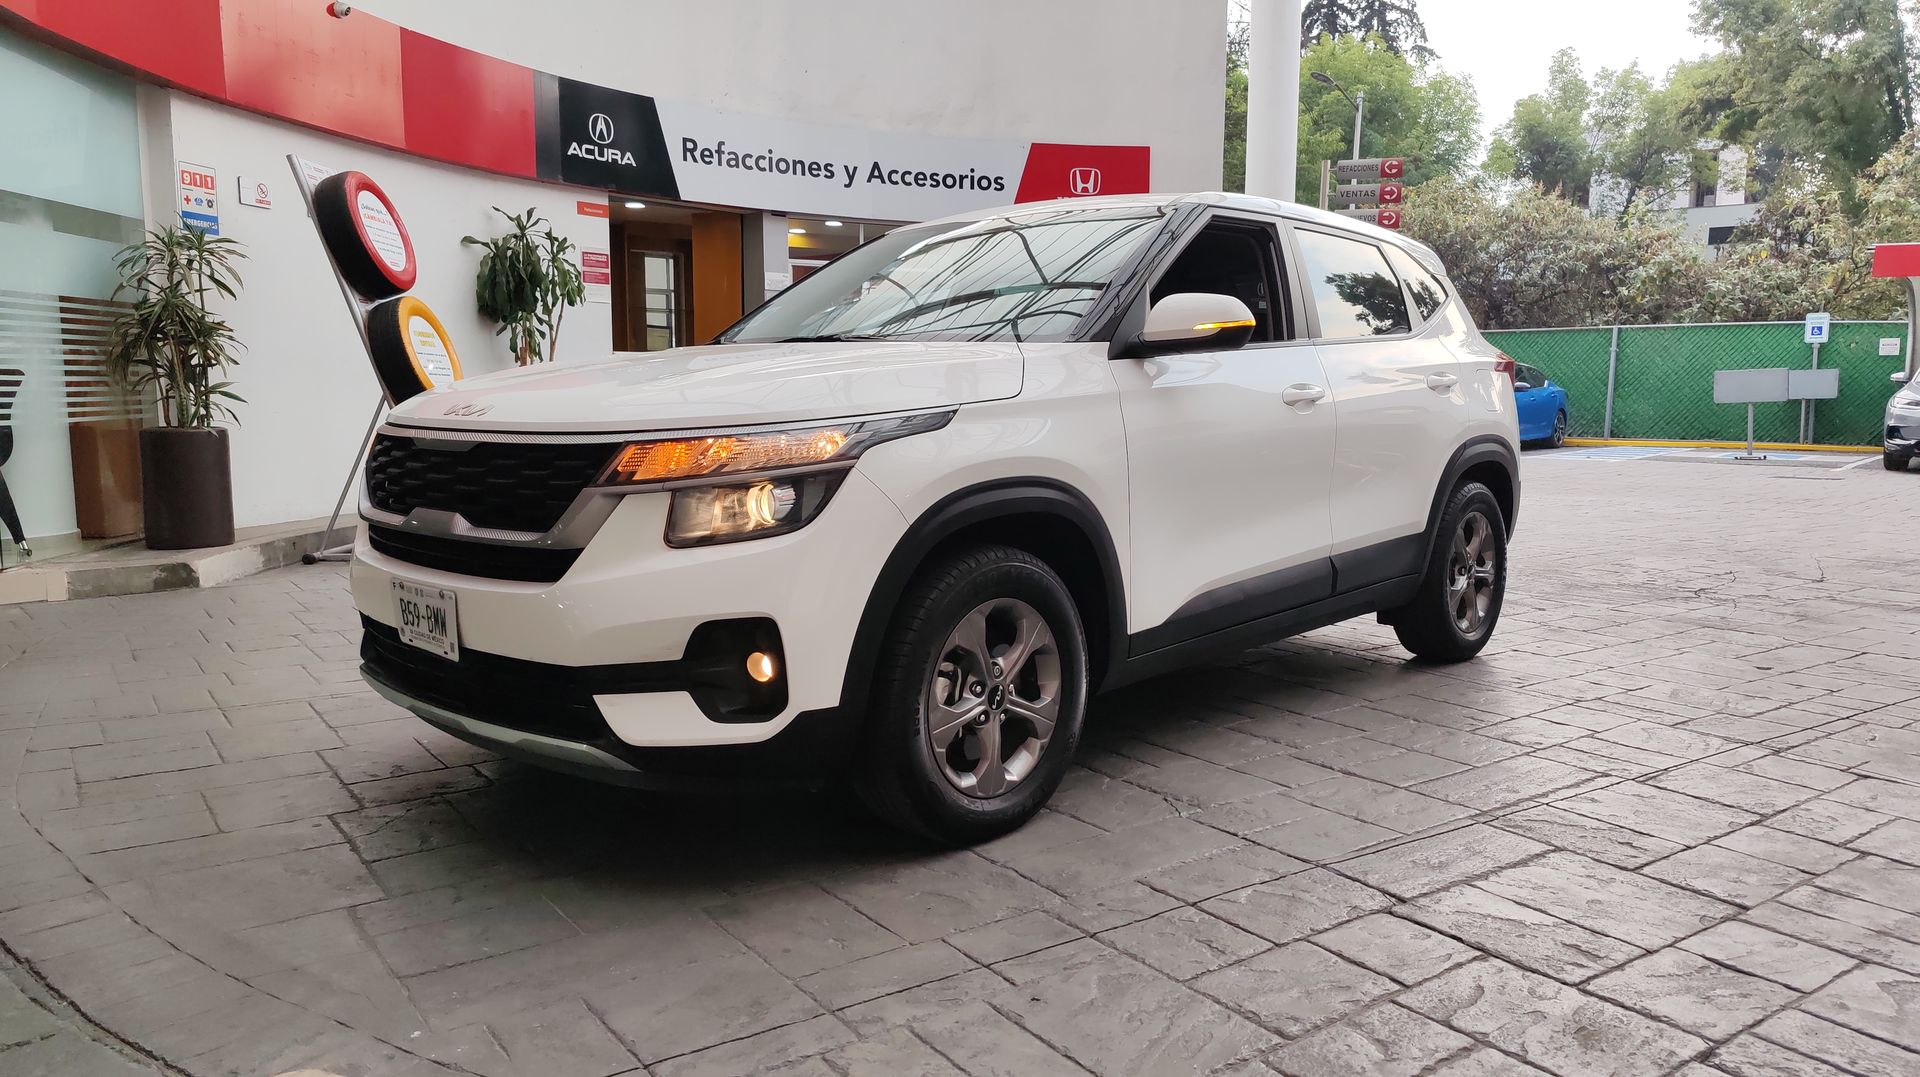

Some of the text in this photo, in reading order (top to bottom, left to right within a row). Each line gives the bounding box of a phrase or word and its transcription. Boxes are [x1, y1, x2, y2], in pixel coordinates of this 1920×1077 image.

[567, 142, 637, 167] ACURA
[682, 136, 1006, 192] Refacciones y Accesorios
[1339, 163, 1379, 173] REFACCIONES
[183, 172, 212, 189] 911
[1340, 189, 1376, 198] VENTAS
[399, 598, 448, 639] B59-BMW
